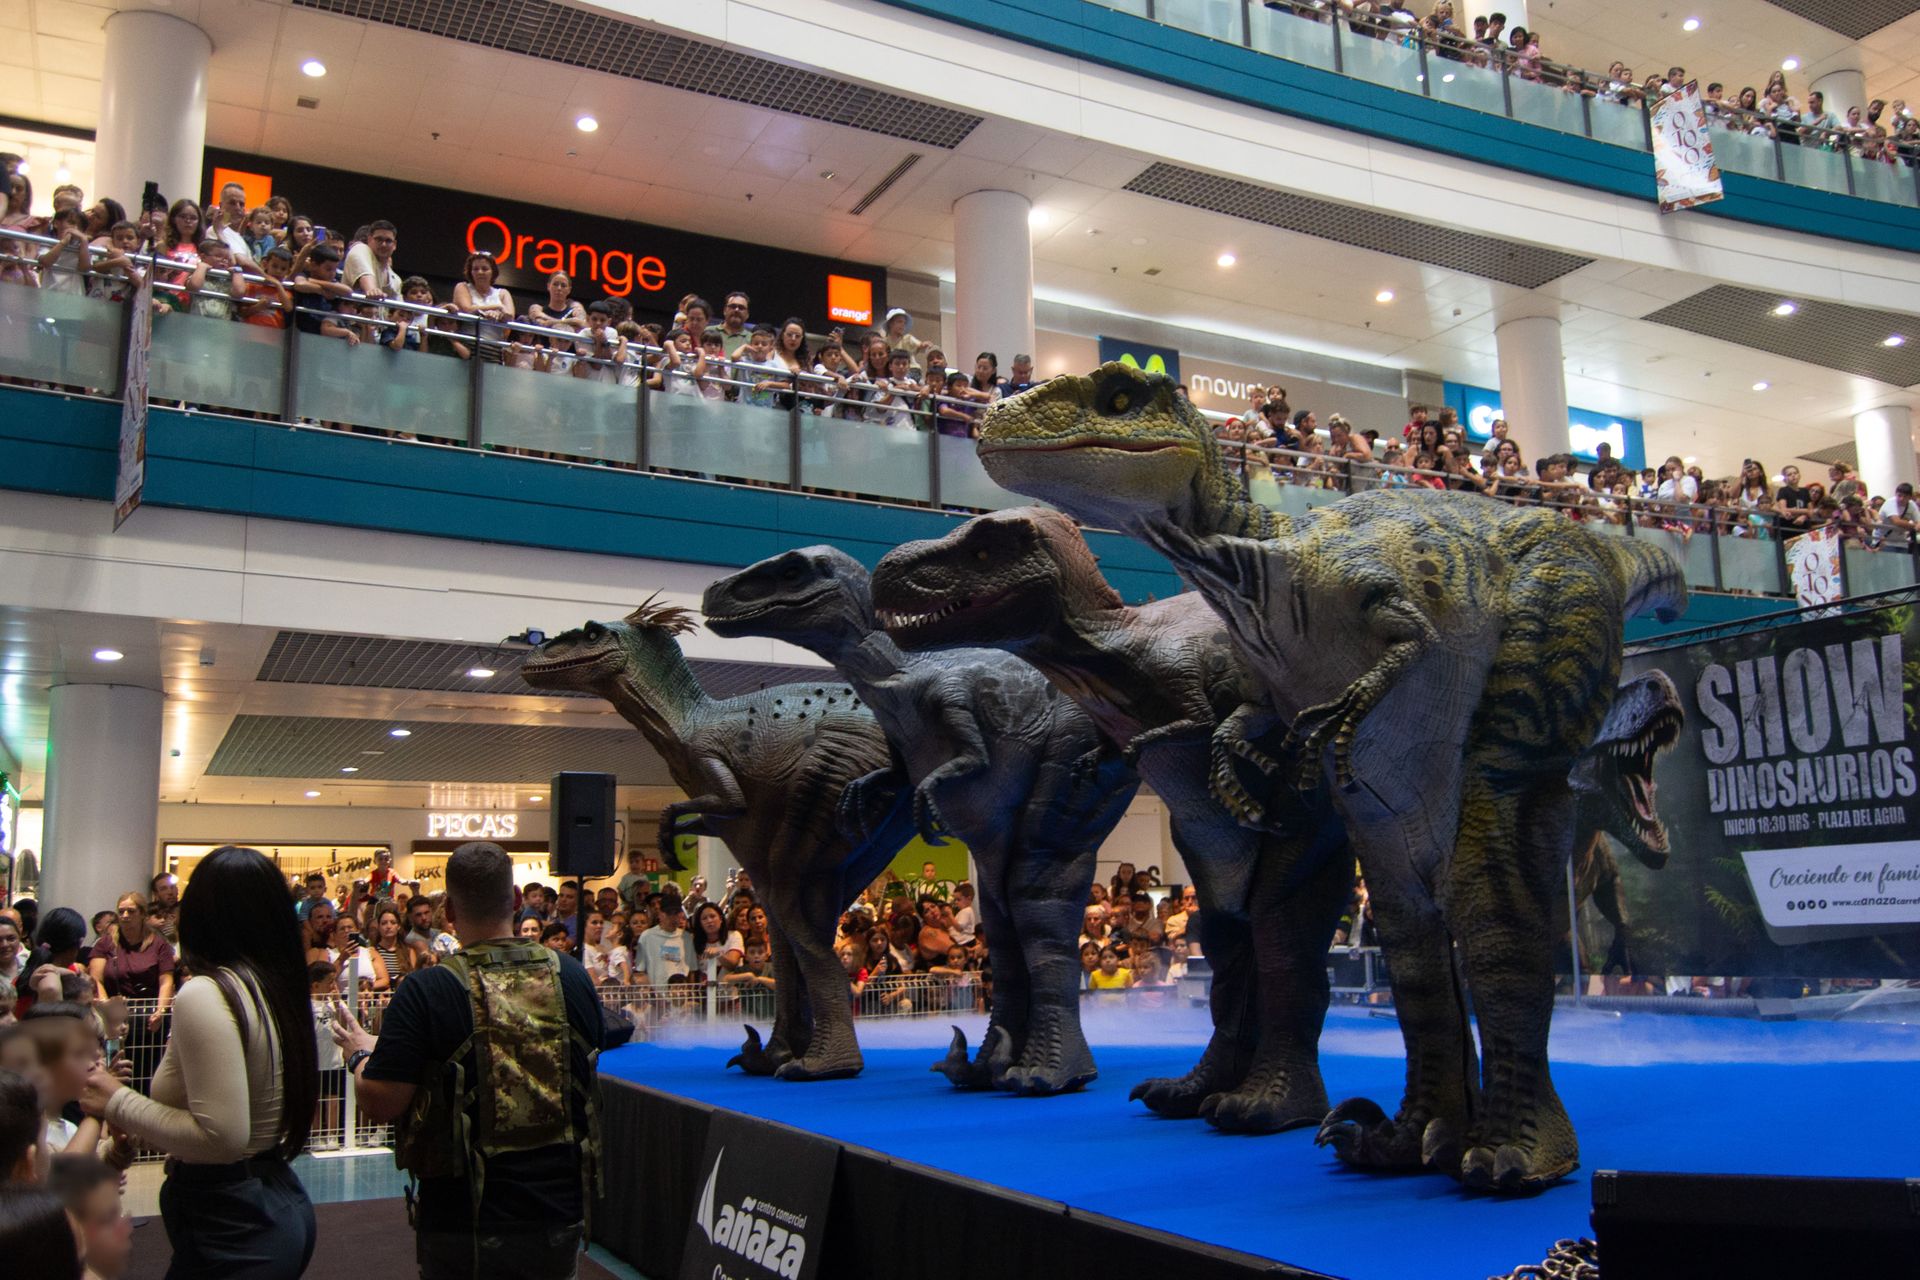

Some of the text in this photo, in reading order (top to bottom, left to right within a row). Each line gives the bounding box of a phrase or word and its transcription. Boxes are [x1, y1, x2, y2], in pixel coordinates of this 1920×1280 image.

[466, 216, 666, 298] Orange
[831, 307, 870, 322] orange
[1696, 633, 1905, 765] SHOW
[1707, 747, 1917, 813] DINOSAURIOS
[1724, 806, 1906, 837] INICIO 18:30 HRS PLAZA DEL AGUA
[1769, 864, 1850, 889] Creciendo
[1854, 871, 1874, 883] en
[713, 1196, 806, 1280] añaza
[756, 1200, 807, 1230] centro comercial
